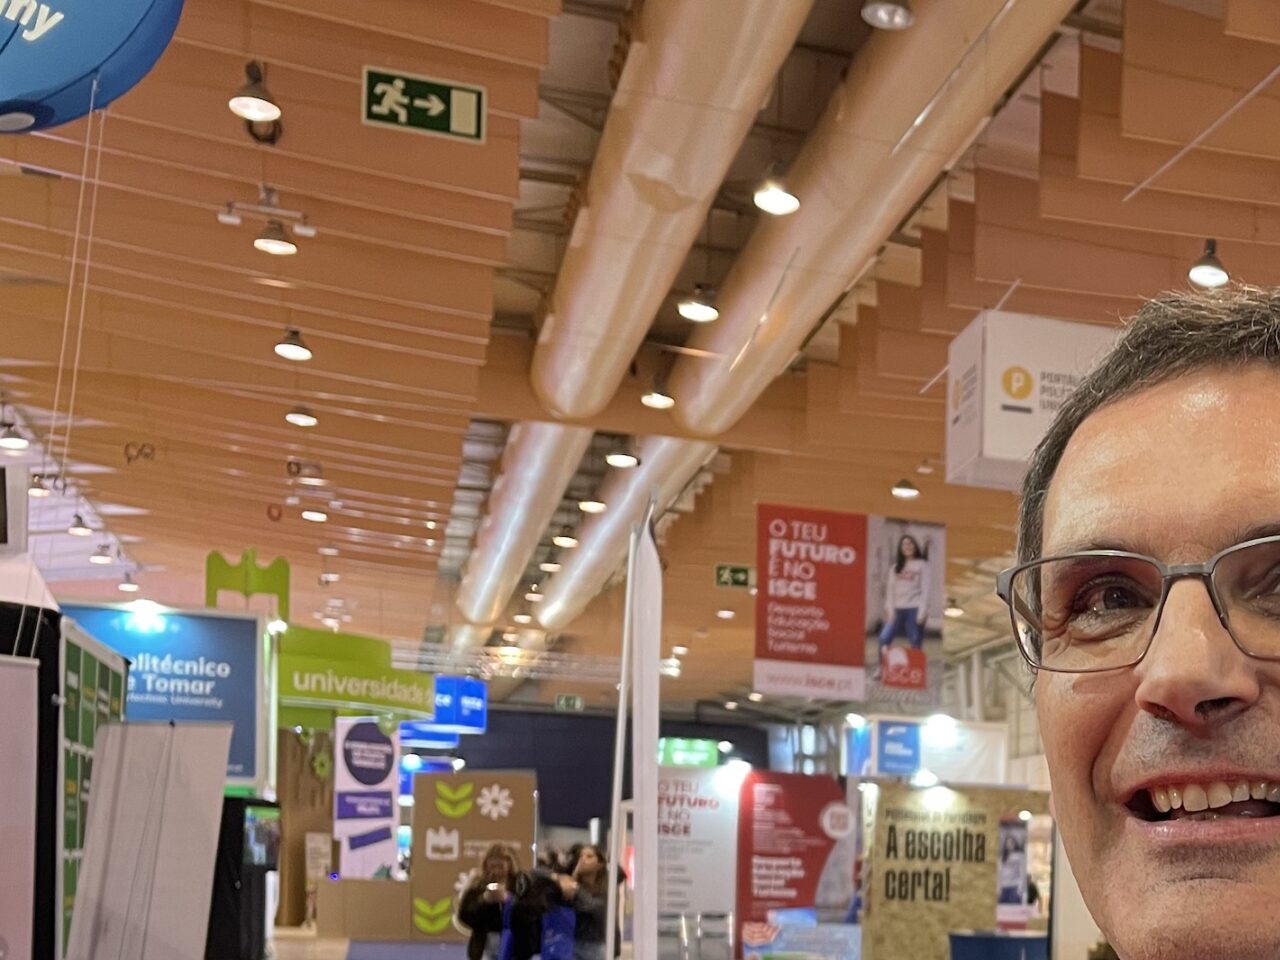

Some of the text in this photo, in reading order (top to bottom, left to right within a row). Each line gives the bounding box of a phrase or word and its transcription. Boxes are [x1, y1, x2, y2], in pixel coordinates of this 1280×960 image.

[0, 0, 64, 41] ny
[769, 518, 827, 543] O TEU
[769, 537, 856, 565] FUTURO
[783, 558, 816, 580] NO
[768, 578, 816, 600] ISCE
[129, 652, 231, 678] olitécnico
[143, 673, 216, 695] Tomar
[886, 824, 985, 863] A escolha
[885, 866, 950, 902] certa!
